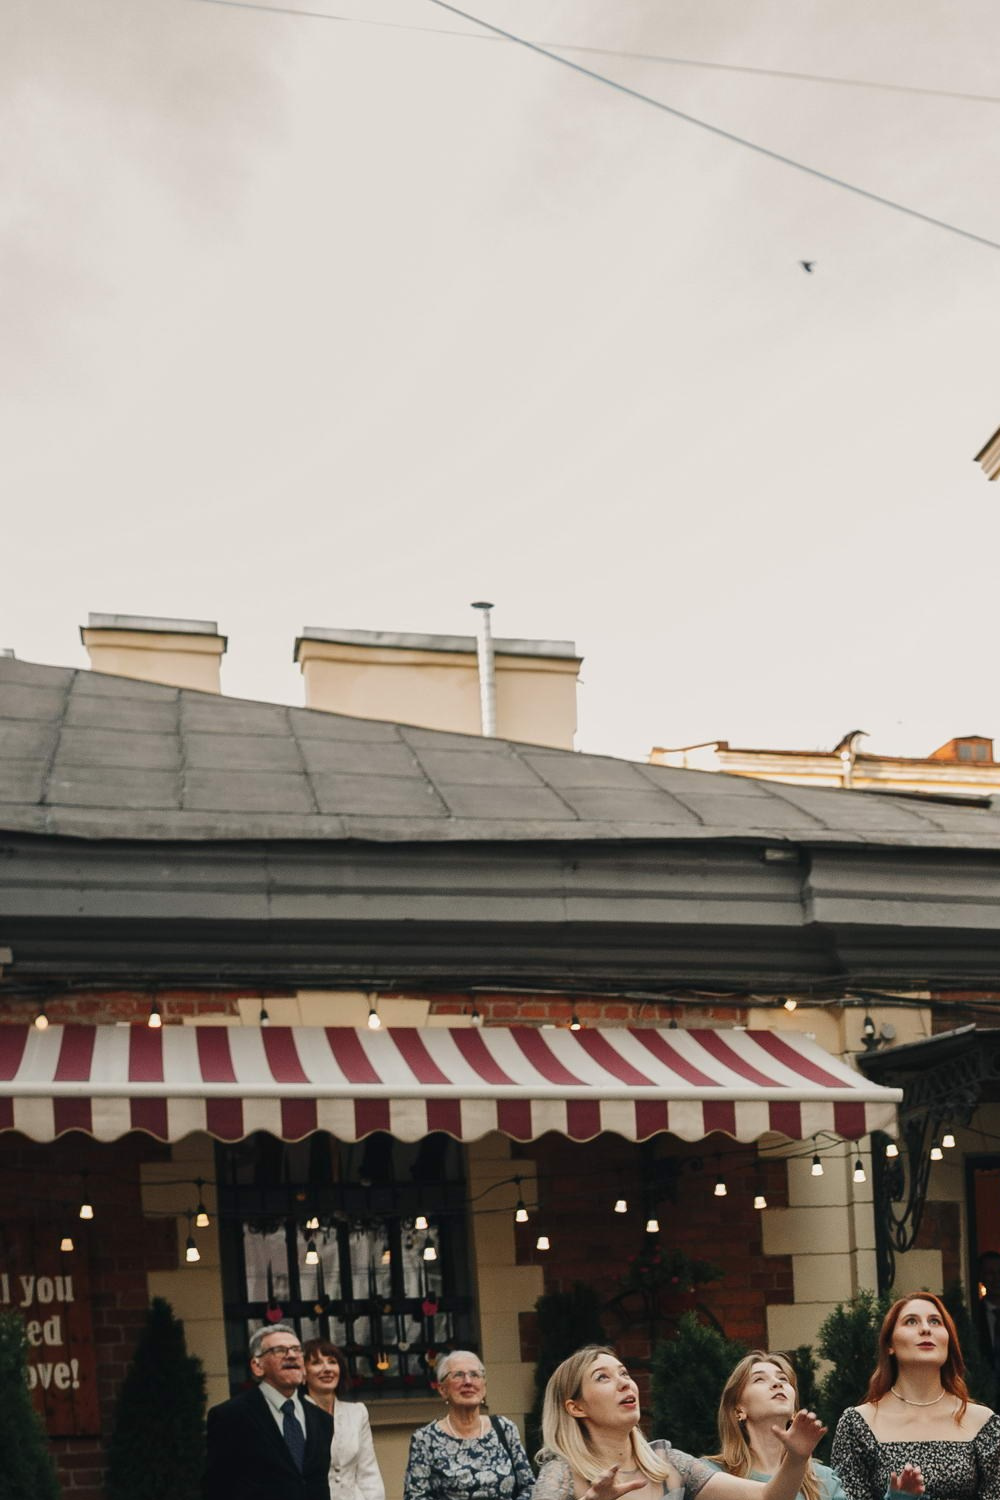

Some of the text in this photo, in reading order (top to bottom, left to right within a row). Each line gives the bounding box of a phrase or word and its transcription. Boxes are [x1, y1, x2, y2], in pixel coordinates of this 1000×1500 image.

[19, 1275, 75, 1308] you
[27, 1314, 64, 1347] ed
[26, 1358, 80, 1390] ove!
